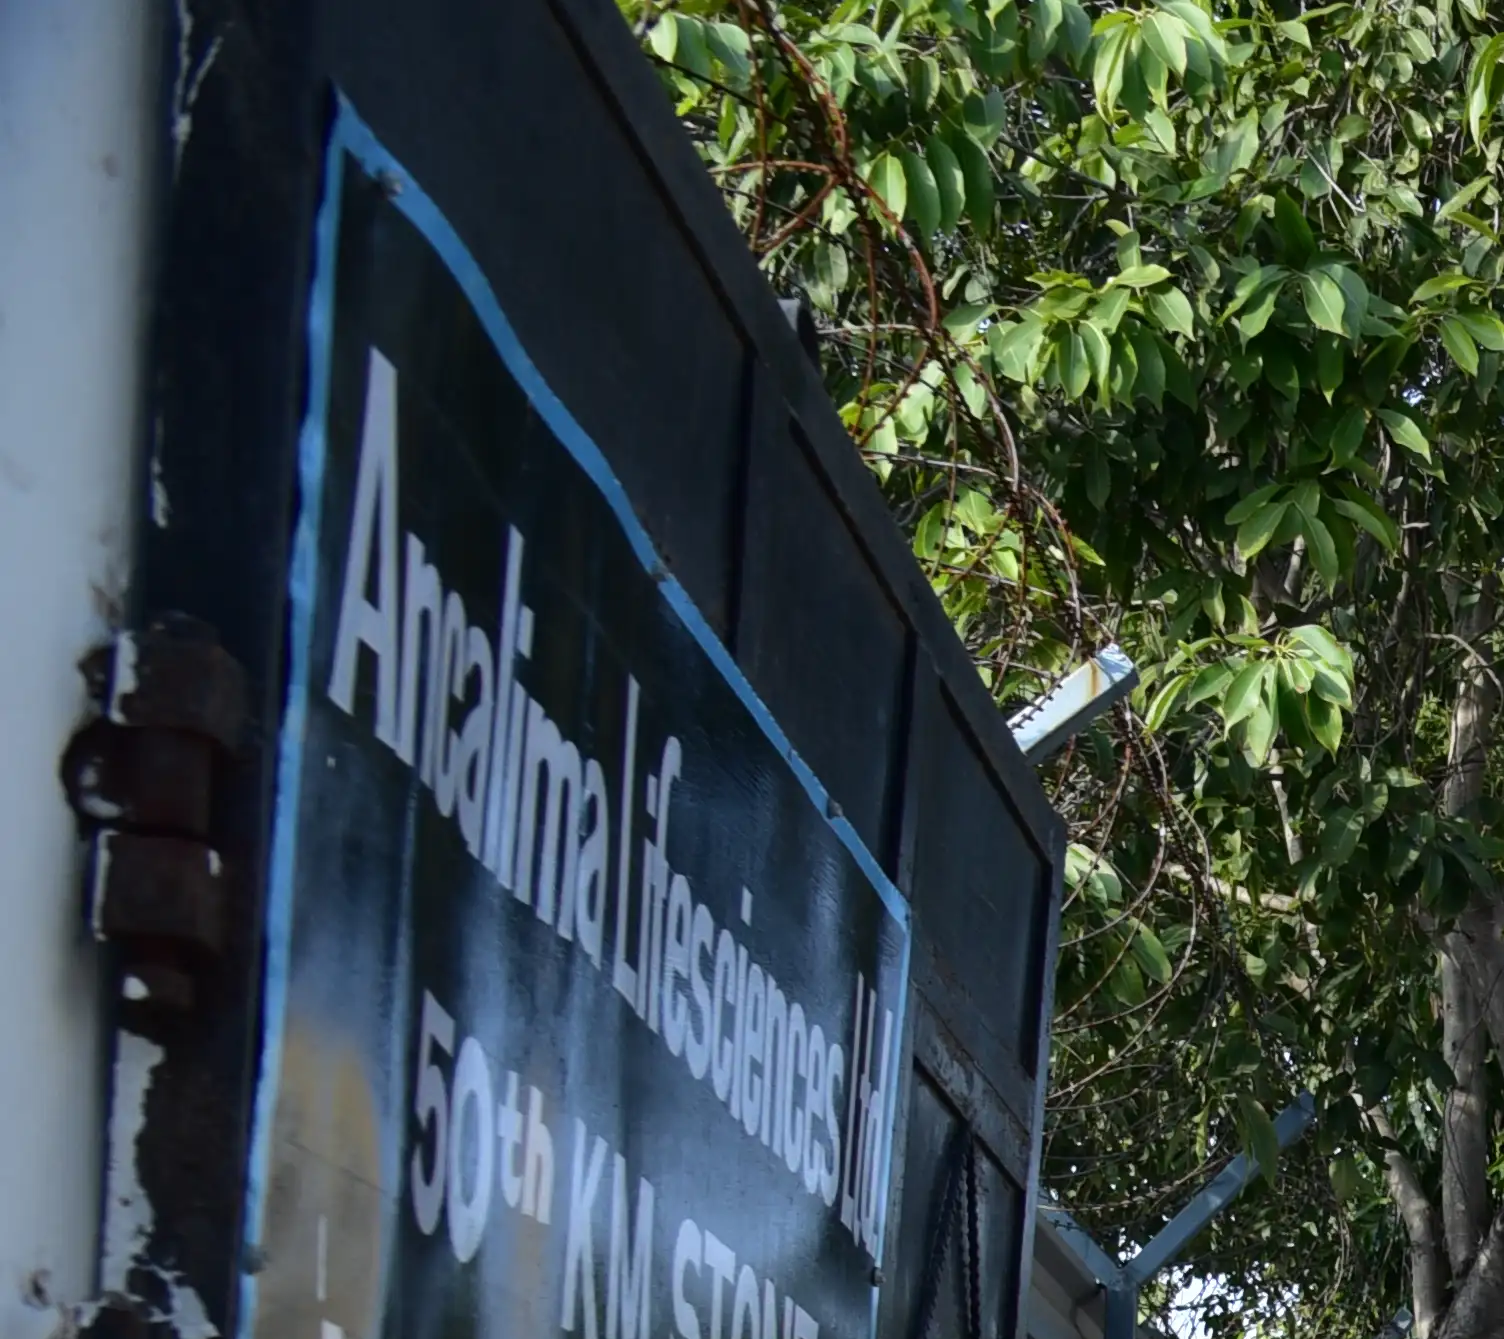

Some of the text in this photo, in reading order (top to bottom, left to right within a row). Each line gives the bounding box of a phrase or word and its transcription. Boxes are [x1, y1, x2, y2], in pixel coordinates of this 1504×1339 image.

[328, 345, 609, 971] Ancalima
[612, 671, 846, 1209] Lifesciences
[411, 987, 555, 1264] 50th
